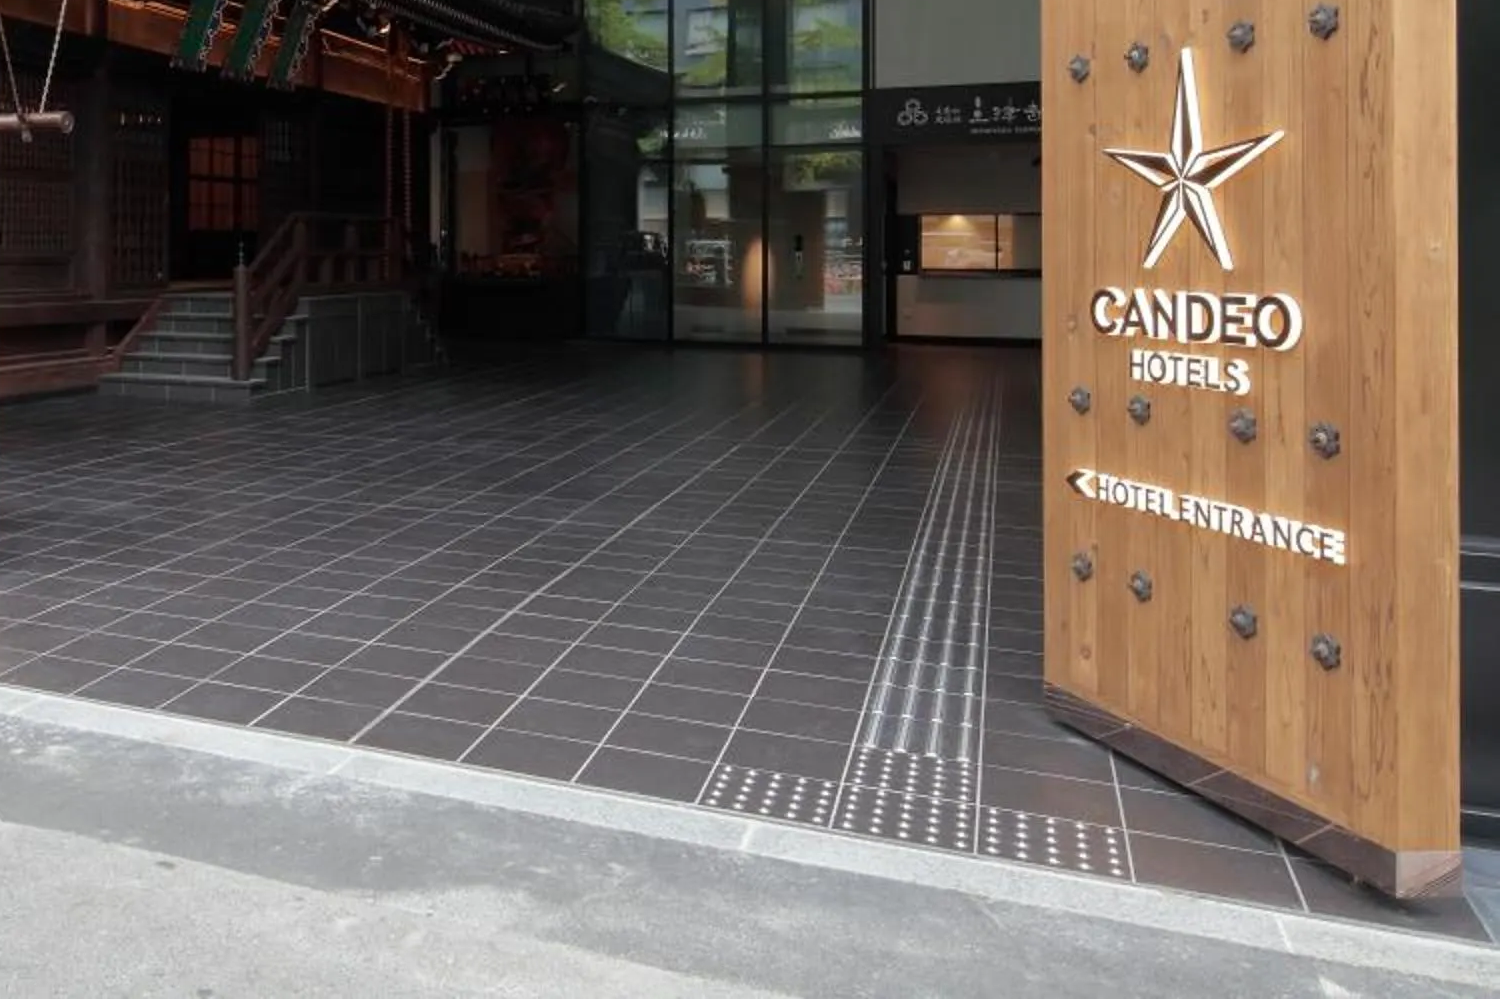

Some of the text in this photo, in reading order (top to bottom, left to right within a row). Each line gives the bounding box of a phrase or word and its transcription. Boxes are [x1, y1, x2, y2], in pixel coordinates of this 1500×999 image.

[1090, 286, 1304, 351] CANDEO
[1129, 349, 1251, 395] HOTELS
[1096, 473, 1345, 565] HOTEL ENTRANCE
